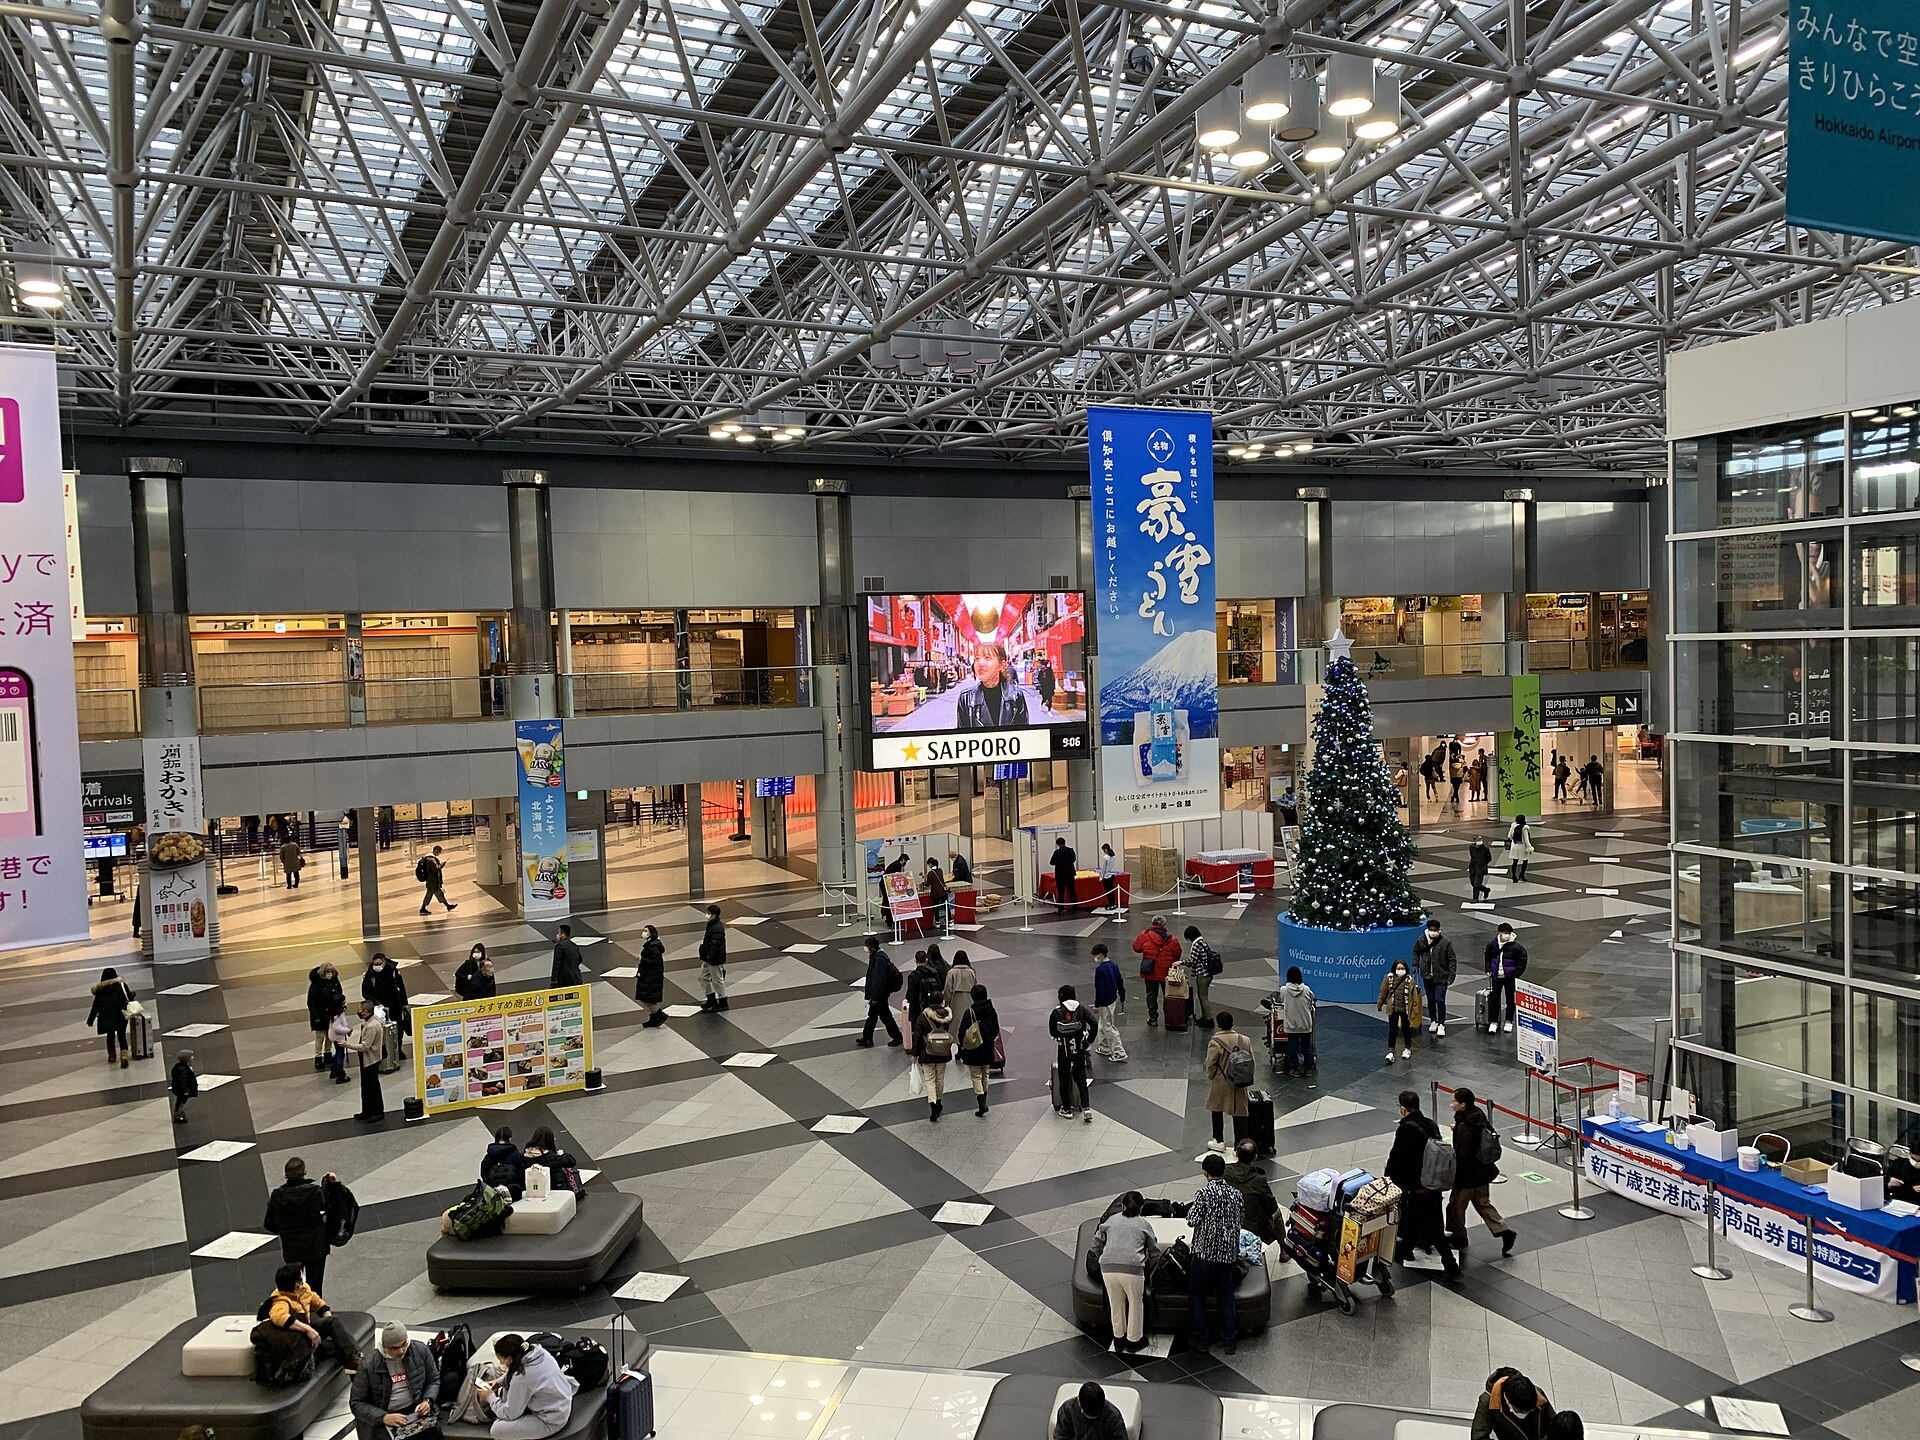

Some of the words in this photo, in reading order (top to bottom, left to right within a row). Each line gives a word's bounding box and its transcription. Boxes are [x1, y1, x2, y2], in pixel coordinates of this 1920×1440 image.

[1797, 6, 1919, 66] みんなで空
[1815, 113, 1875, 142] Hokkaido
[1153, 441, 1169, 451] 名物
[0, 601, 54, 636] 済
[1545, 699, 1585, 708] 国内線到着
[1545, 708, 1574, 716] Domestic
[927, 737, 1021, 761] SAPPORO
[1062, 736, 1081, 748] 9:06
[83, 794, 133, 807] Arrivals
[531, 801, 543, 845] 北海道へ。
[545, 794, 556, 838] ようこそ、
[1288, 948, 1322, 963] Welcome
[1324, 954, 1334, 965] to
[1335, 954, 1386, 968] Hokkaido
[1313, 968, 1340, 979] Chitose
[1341, 972, 1371, 981] Airport
[477, 997, 533, 1014] おすすめ商品
